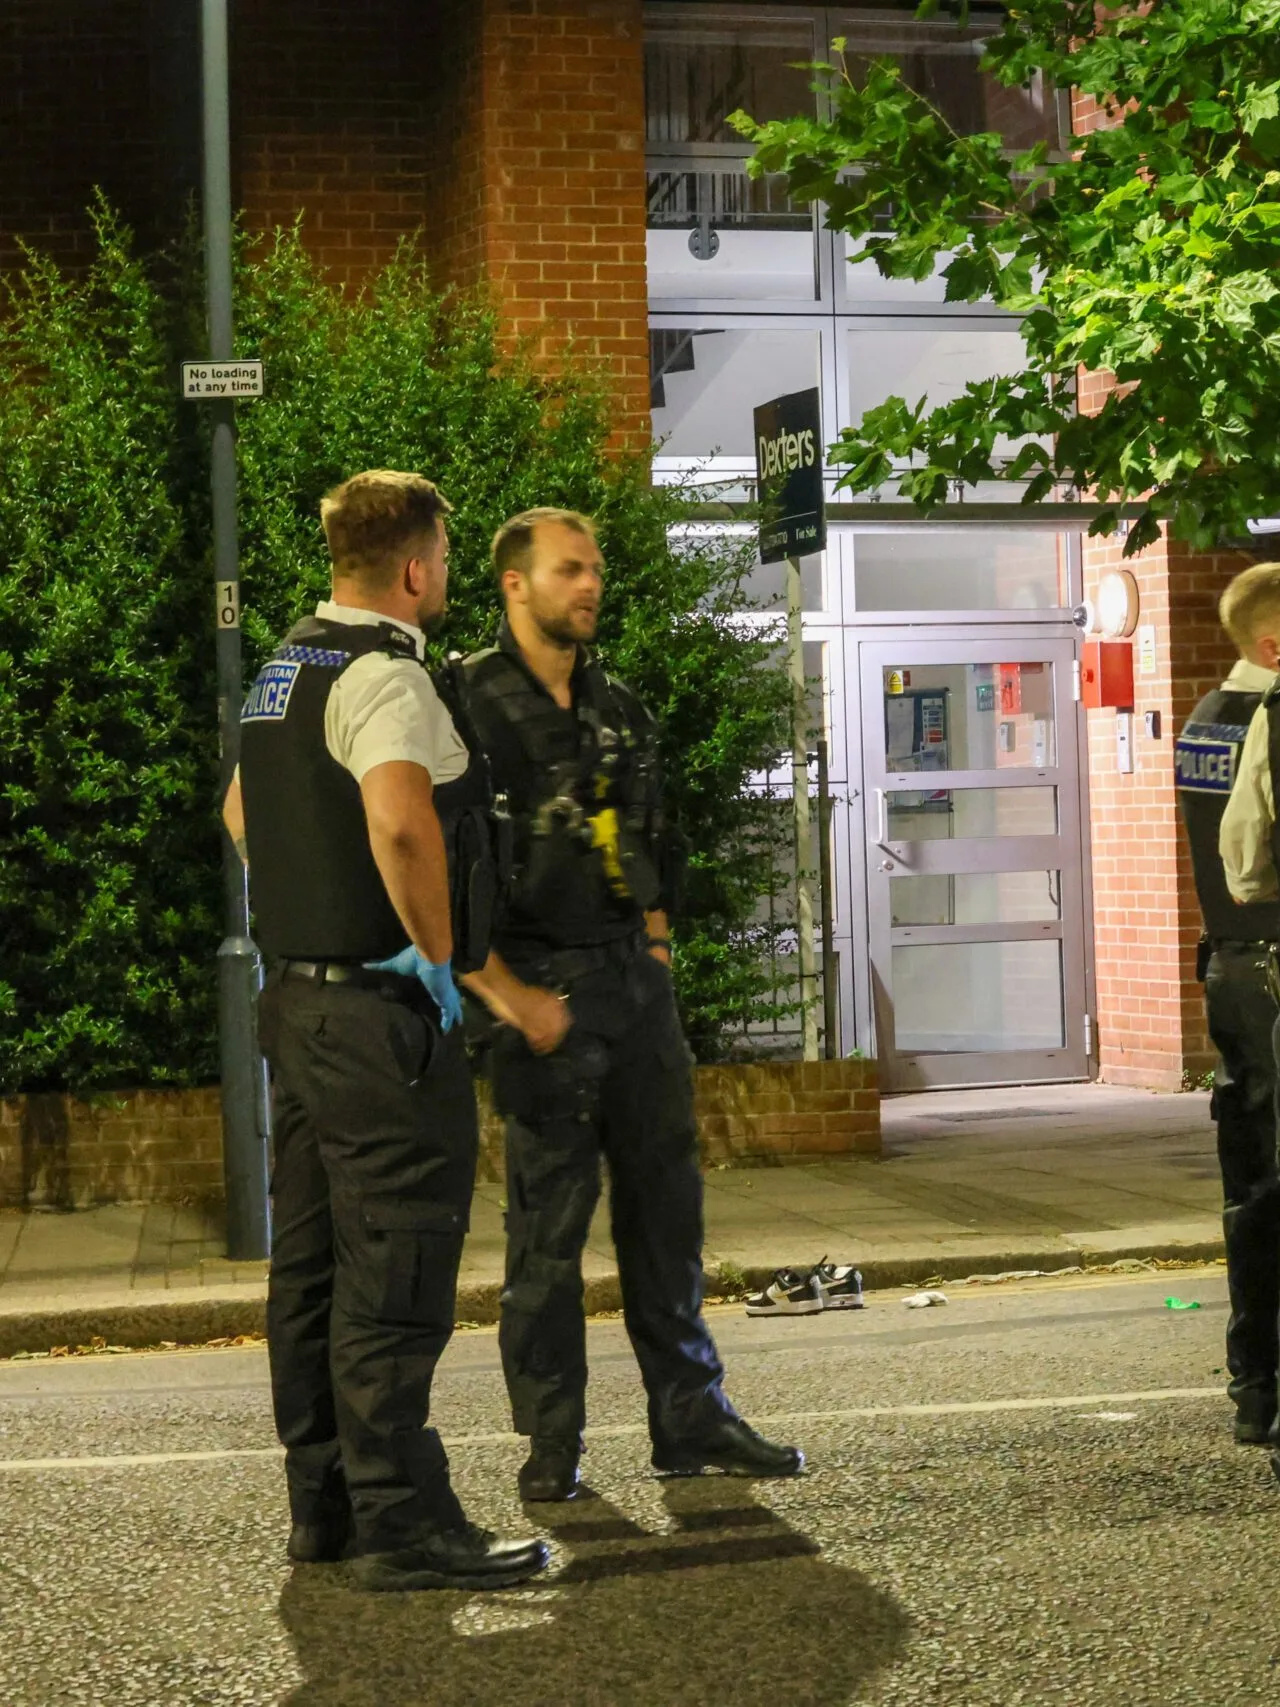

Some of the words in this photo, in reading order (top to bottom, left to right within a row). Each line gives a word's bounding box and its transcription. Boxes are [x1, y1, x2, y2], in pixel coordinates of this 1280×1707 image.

[189, 368, 207, 379] No
[212, 368, 257, 380] loading
[188, 382, 201, 392] at
[205, 383, 227, 393] any
[231, 381, 258, 391] time
[759, 428, 815, 480] Dexters
